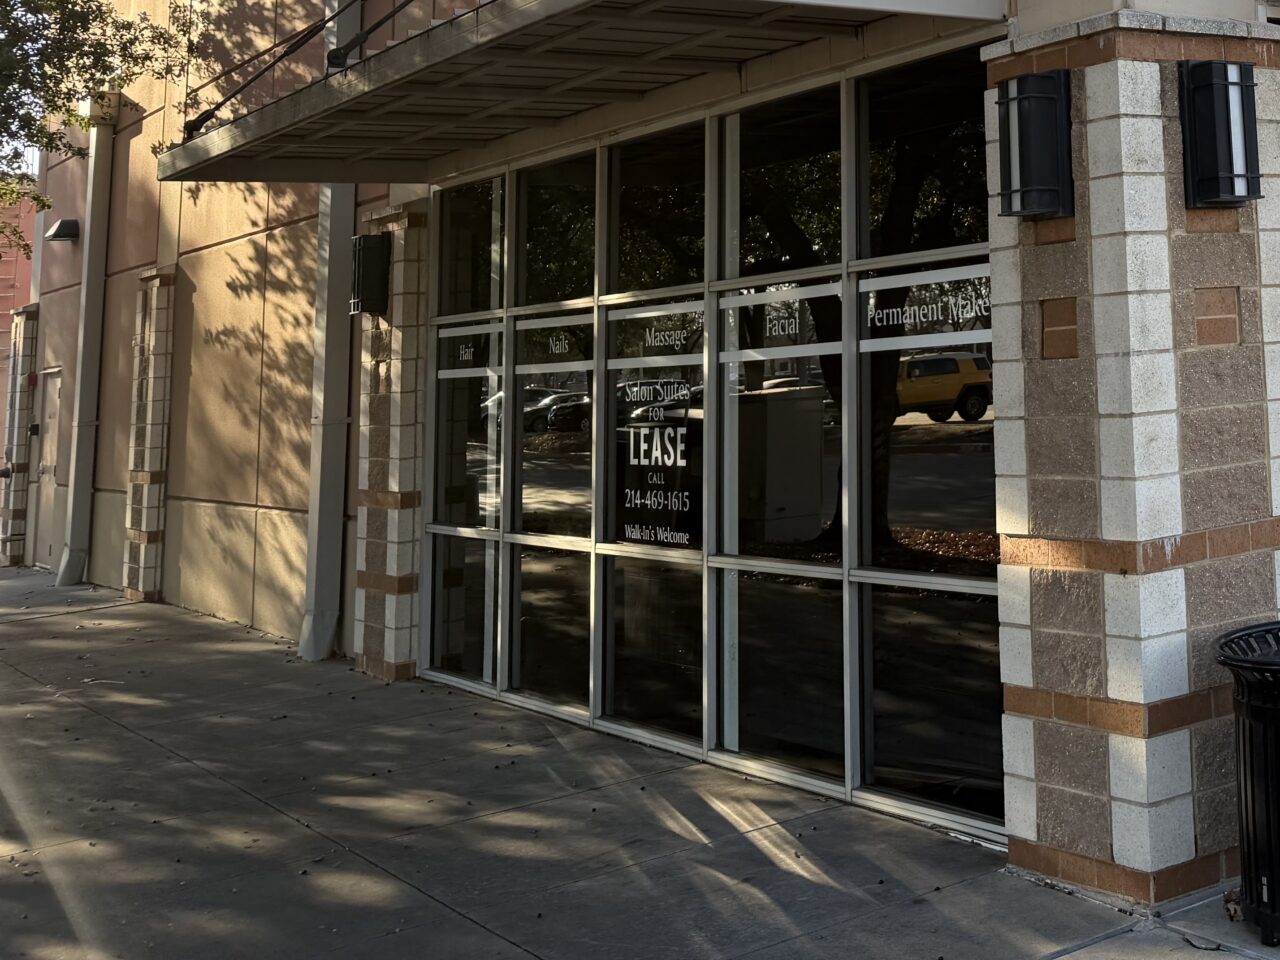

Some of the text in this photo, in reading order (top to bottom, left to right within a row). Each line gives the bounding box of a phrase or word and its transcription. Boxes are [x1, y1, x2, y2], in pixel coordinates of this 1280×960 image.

[867, 292, 990, 328] Permanent Make
[766, 310, 799, 337] Facial
[549, 336, 569, 354] Nails
[645, 327, 687, 350] Massage
[459, 343, 475, 361] Hair
[625, 380, 690, 402] Salon Suites
[648, 407, 665, 421] FOR
[630, 427, 687, 467] LEASE
[647, 472, 665, 485] CALL
[625, 488, 690, 512] 214-469-1615
[624, 523, 690, 545] Walk-In's Welcome
